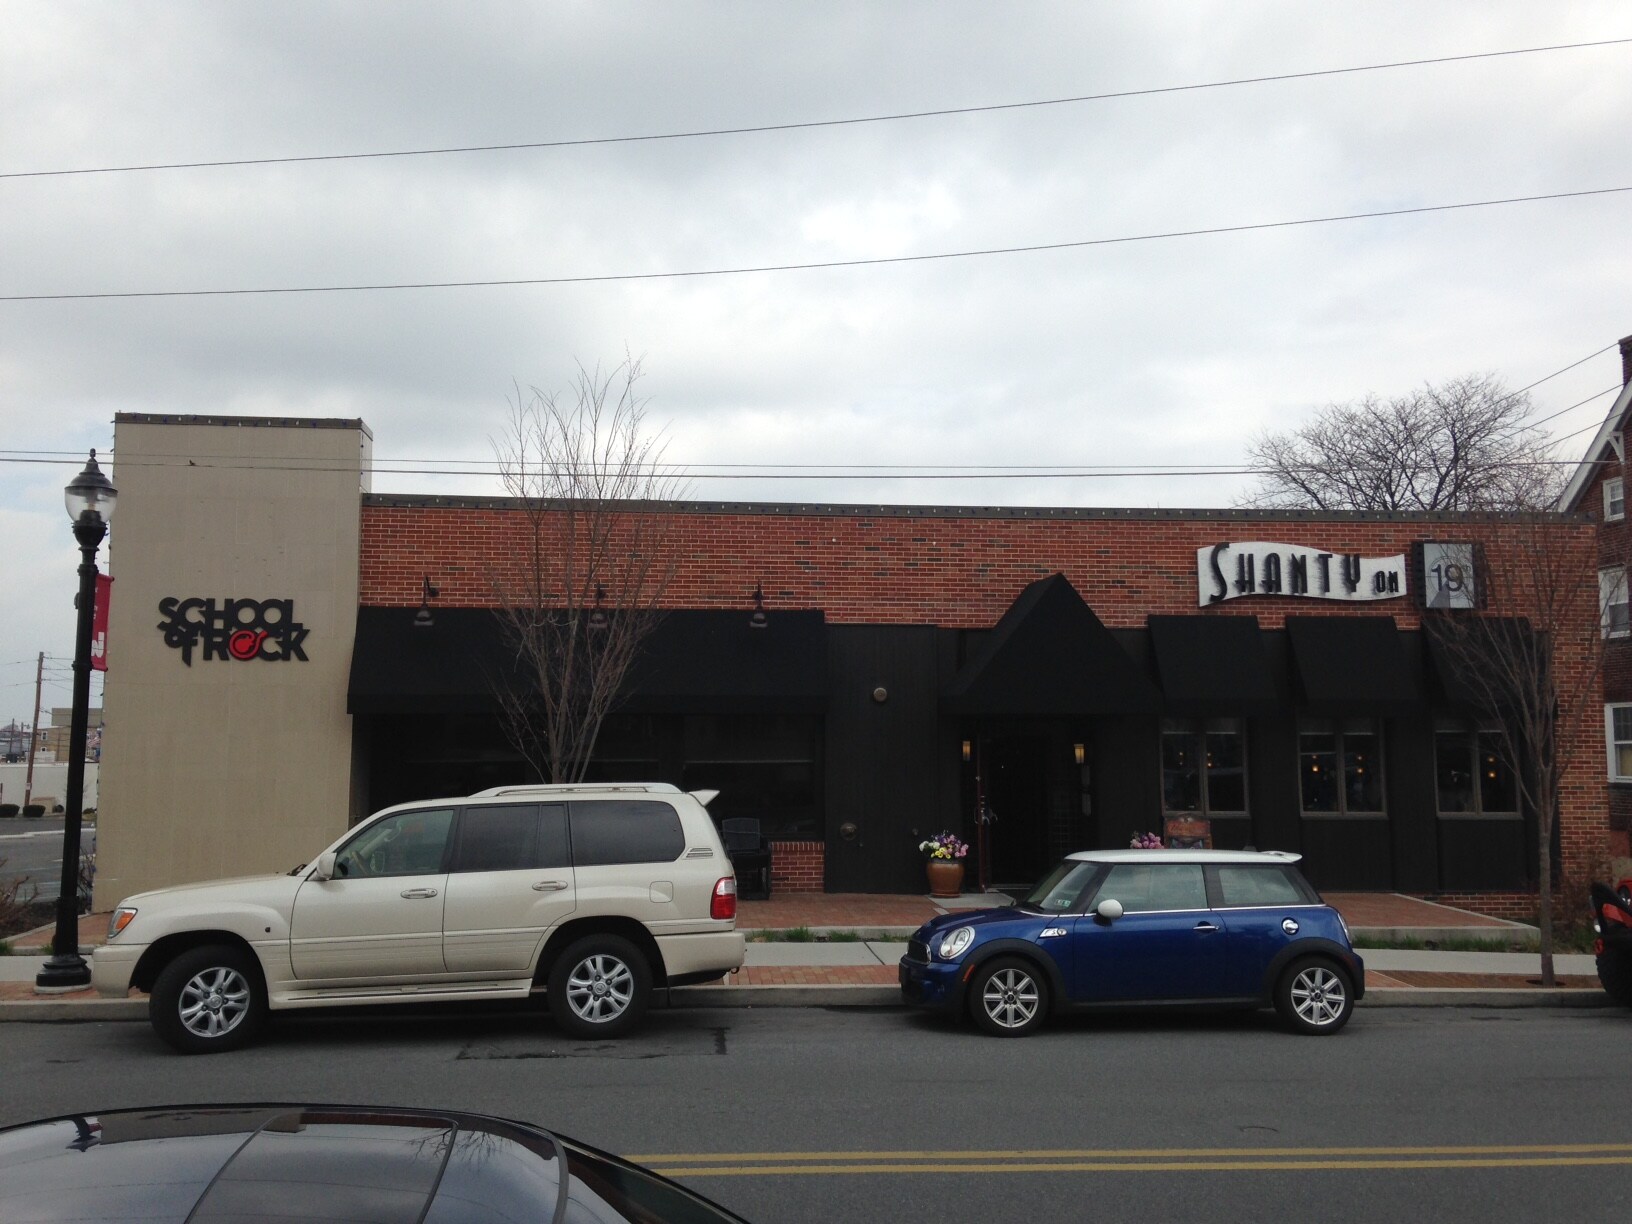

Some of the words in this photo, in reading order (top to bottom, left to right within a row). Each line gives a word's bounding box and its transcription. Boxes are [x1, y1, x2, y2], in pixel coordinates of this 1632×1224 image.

[1210, 542, 1361, 600] SHANTY
[1374, 570, 1399, 593] ON
[157, 597, 303, 633] SCHOOL
[203, 629, 310, 661] ROCK
